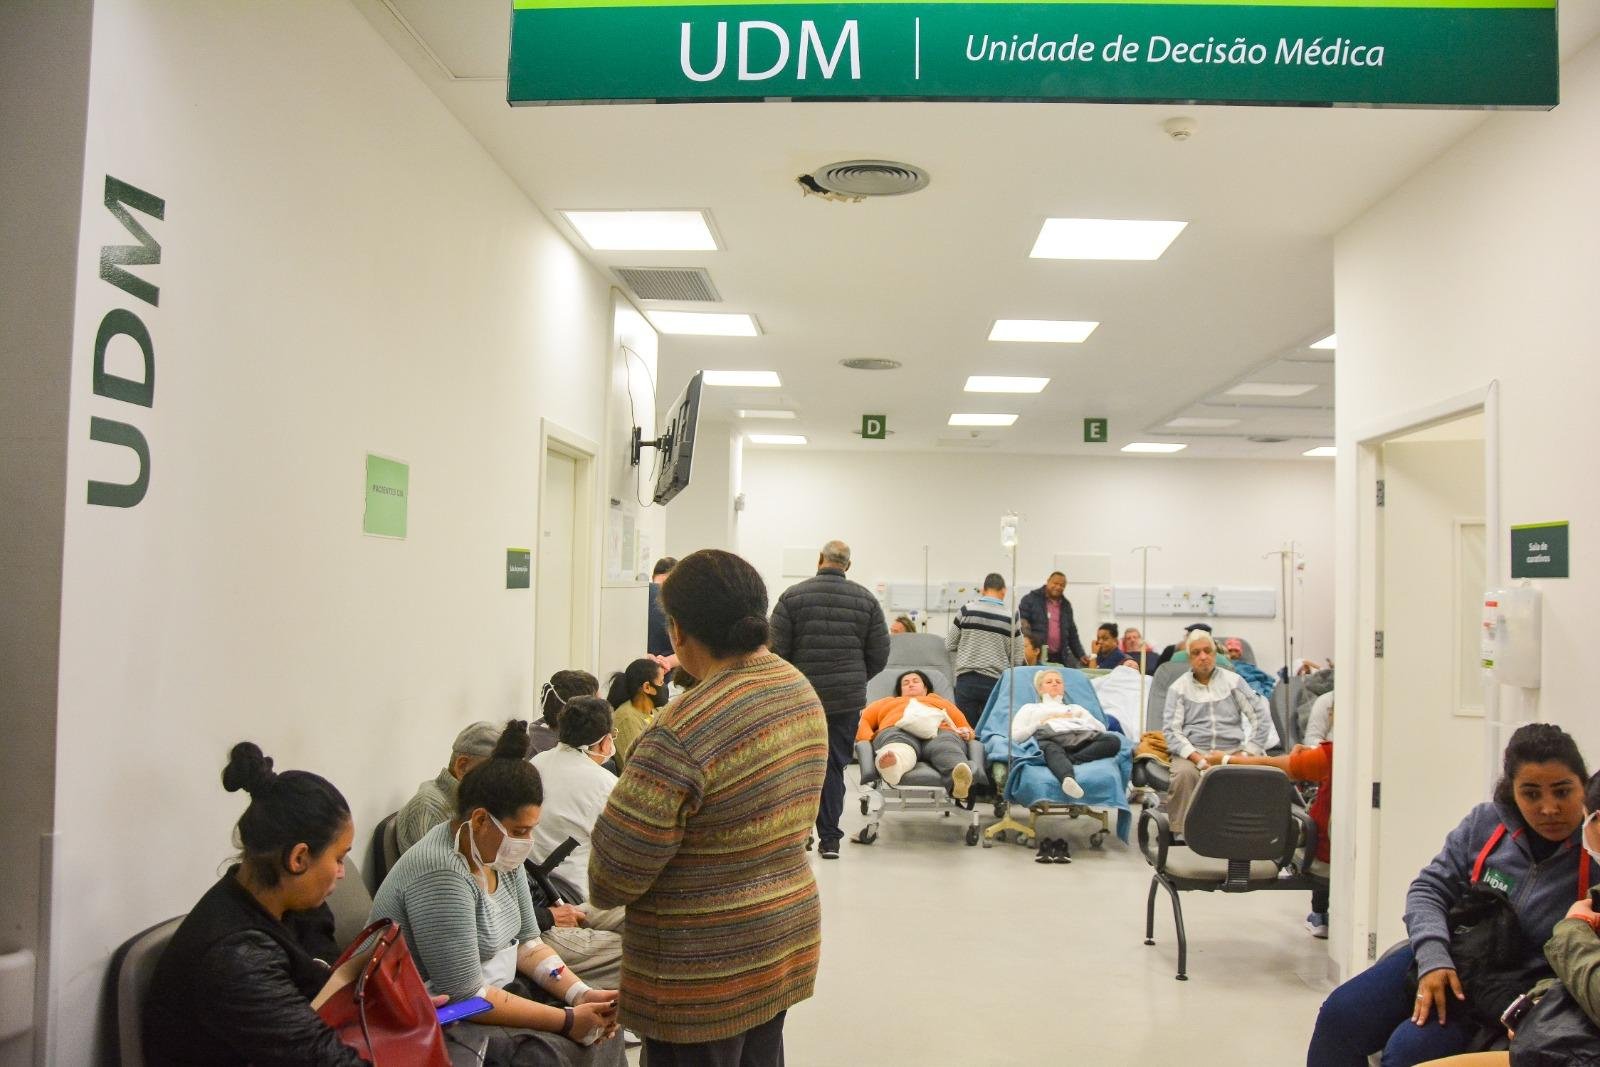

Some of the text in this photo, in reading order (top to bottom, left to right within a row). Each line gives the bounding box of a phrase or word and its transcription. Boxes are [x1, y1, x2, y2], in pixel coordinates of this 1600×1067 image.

[680, 20, 1385, 82] UDM Unidade de Decisão Médica
[86, 174, 166, 508] UDM
[867, 419, 881, 435] D
[1090, 422, 1101, 438] E
[1528, 542, 1541, 551] Sala
